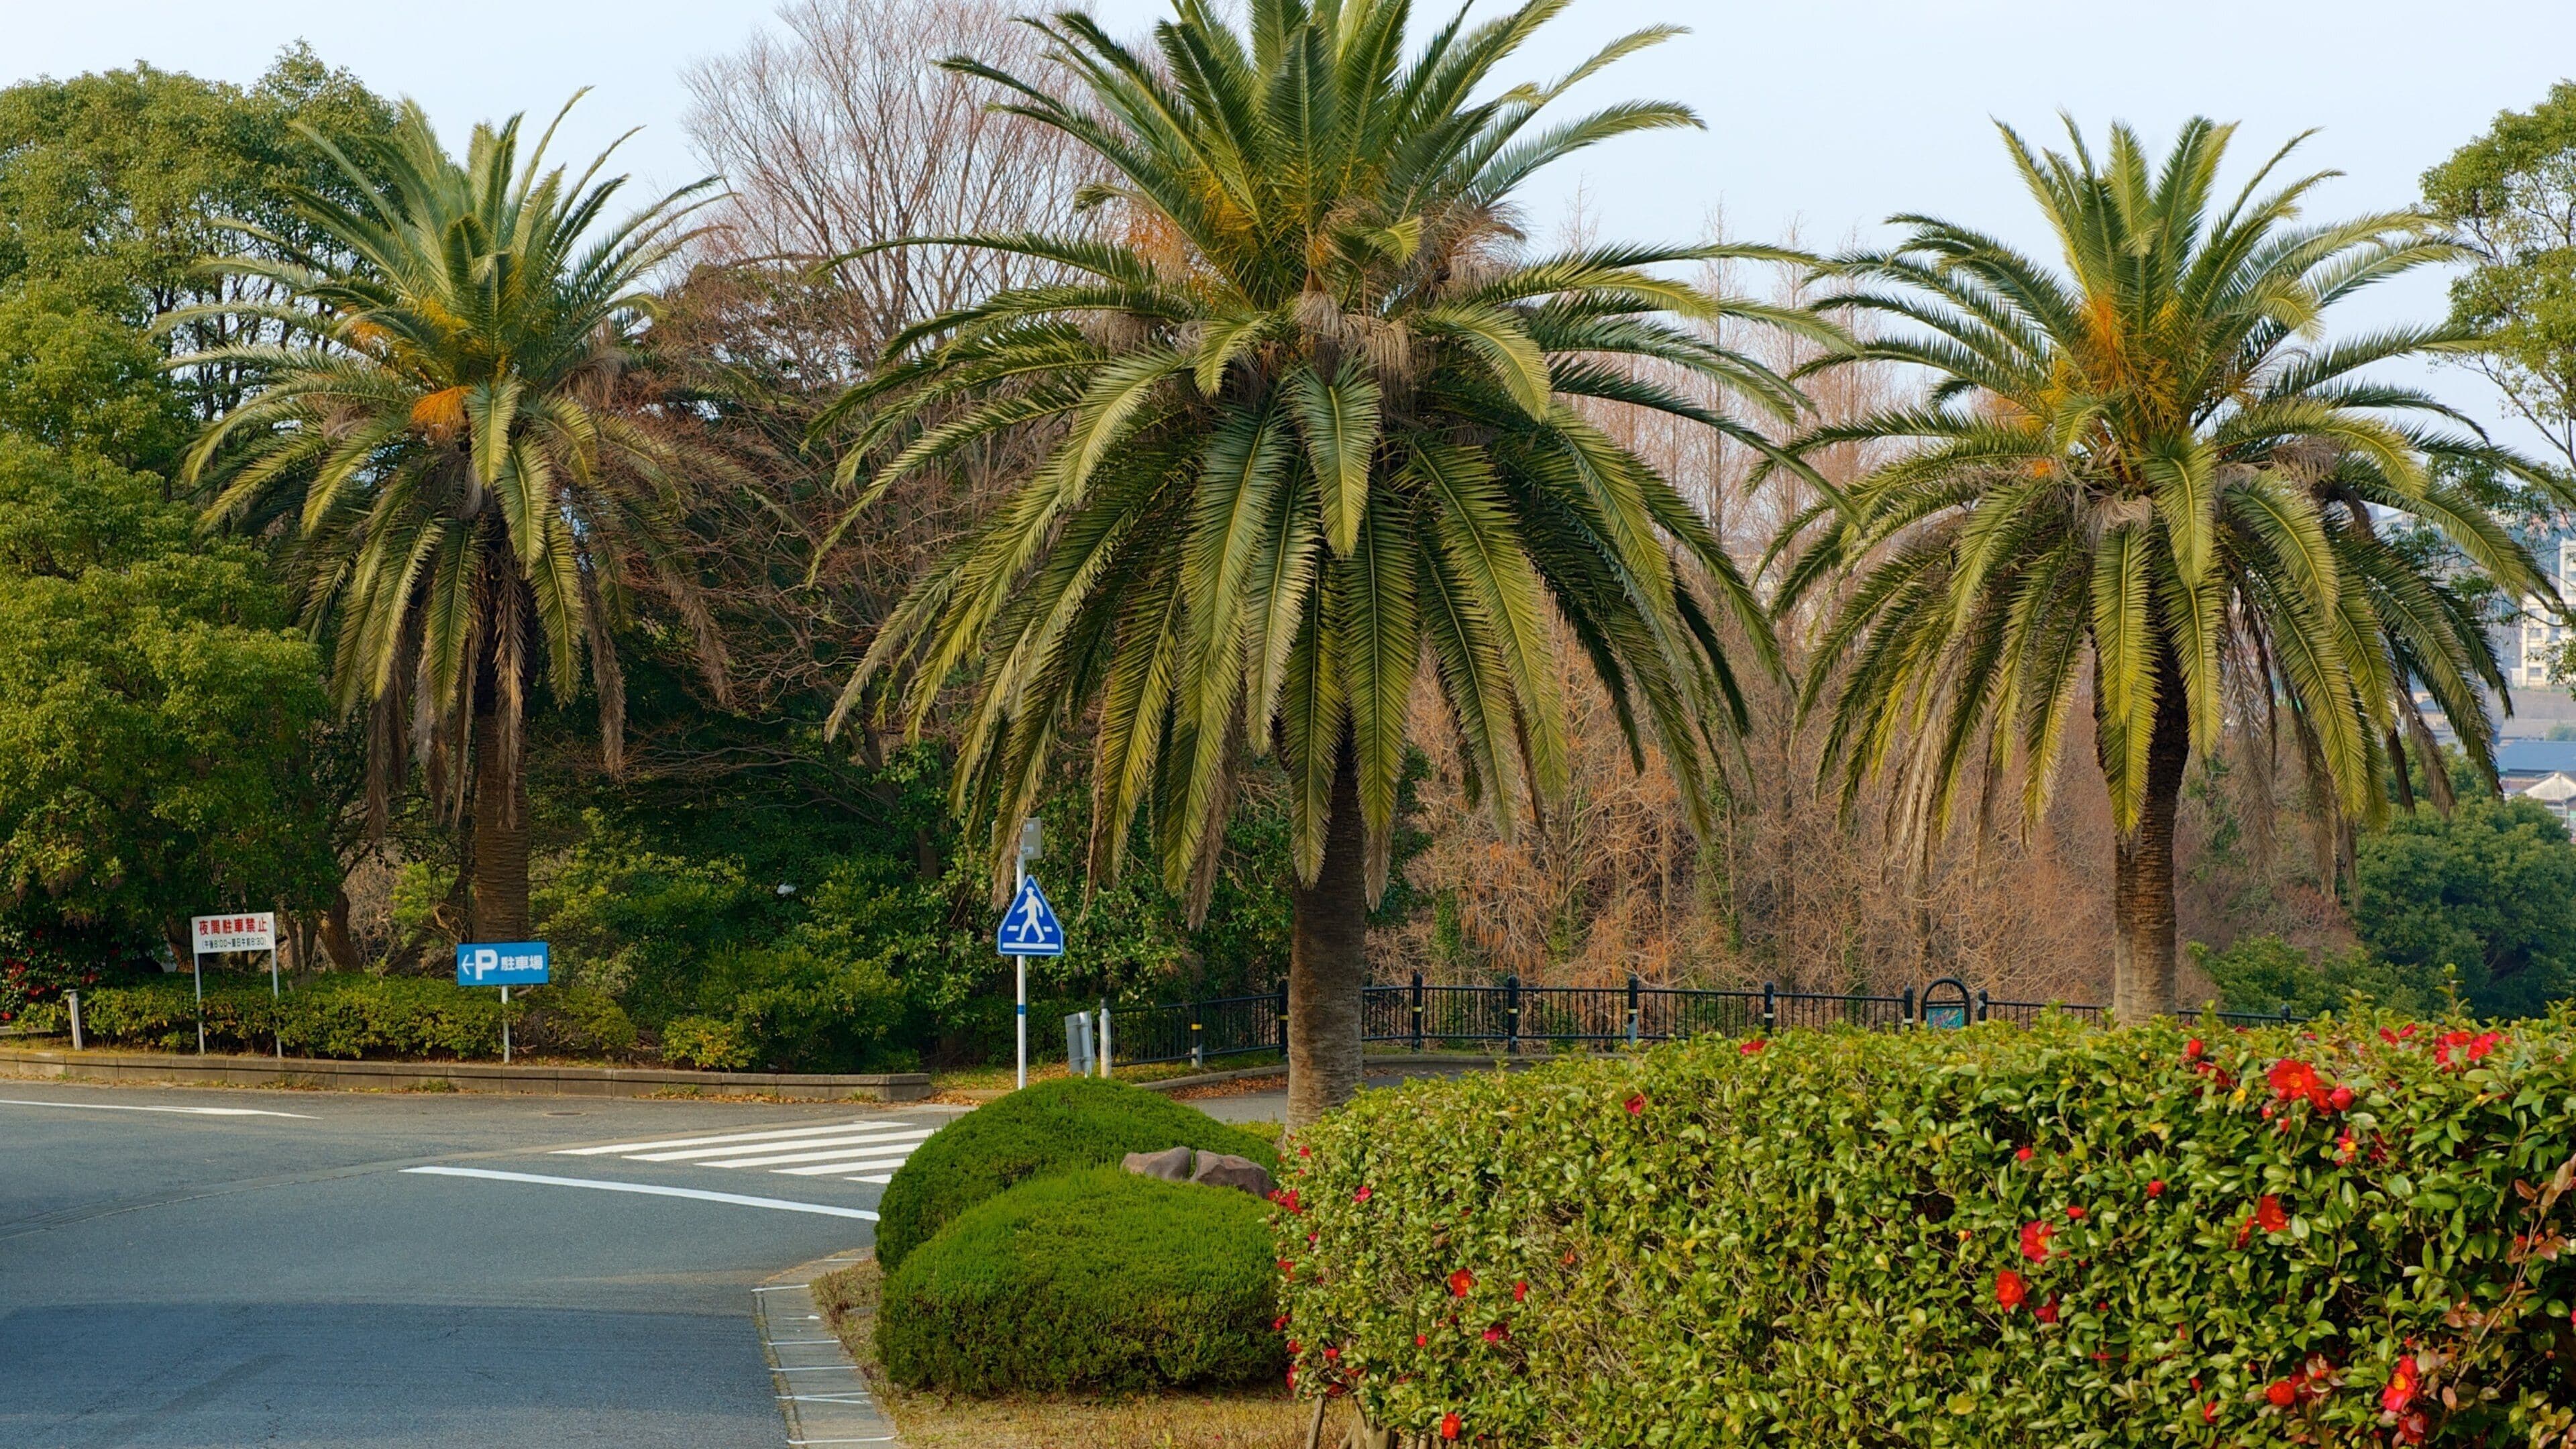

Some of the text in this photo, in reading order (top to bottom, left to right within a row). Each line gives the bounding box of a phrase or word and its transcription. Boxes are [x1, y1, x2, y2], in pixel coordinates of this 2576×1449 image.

[199, 917, 267, 935] 夜間駐車禁止
[475, 949, 544, 980] P 駐車場
